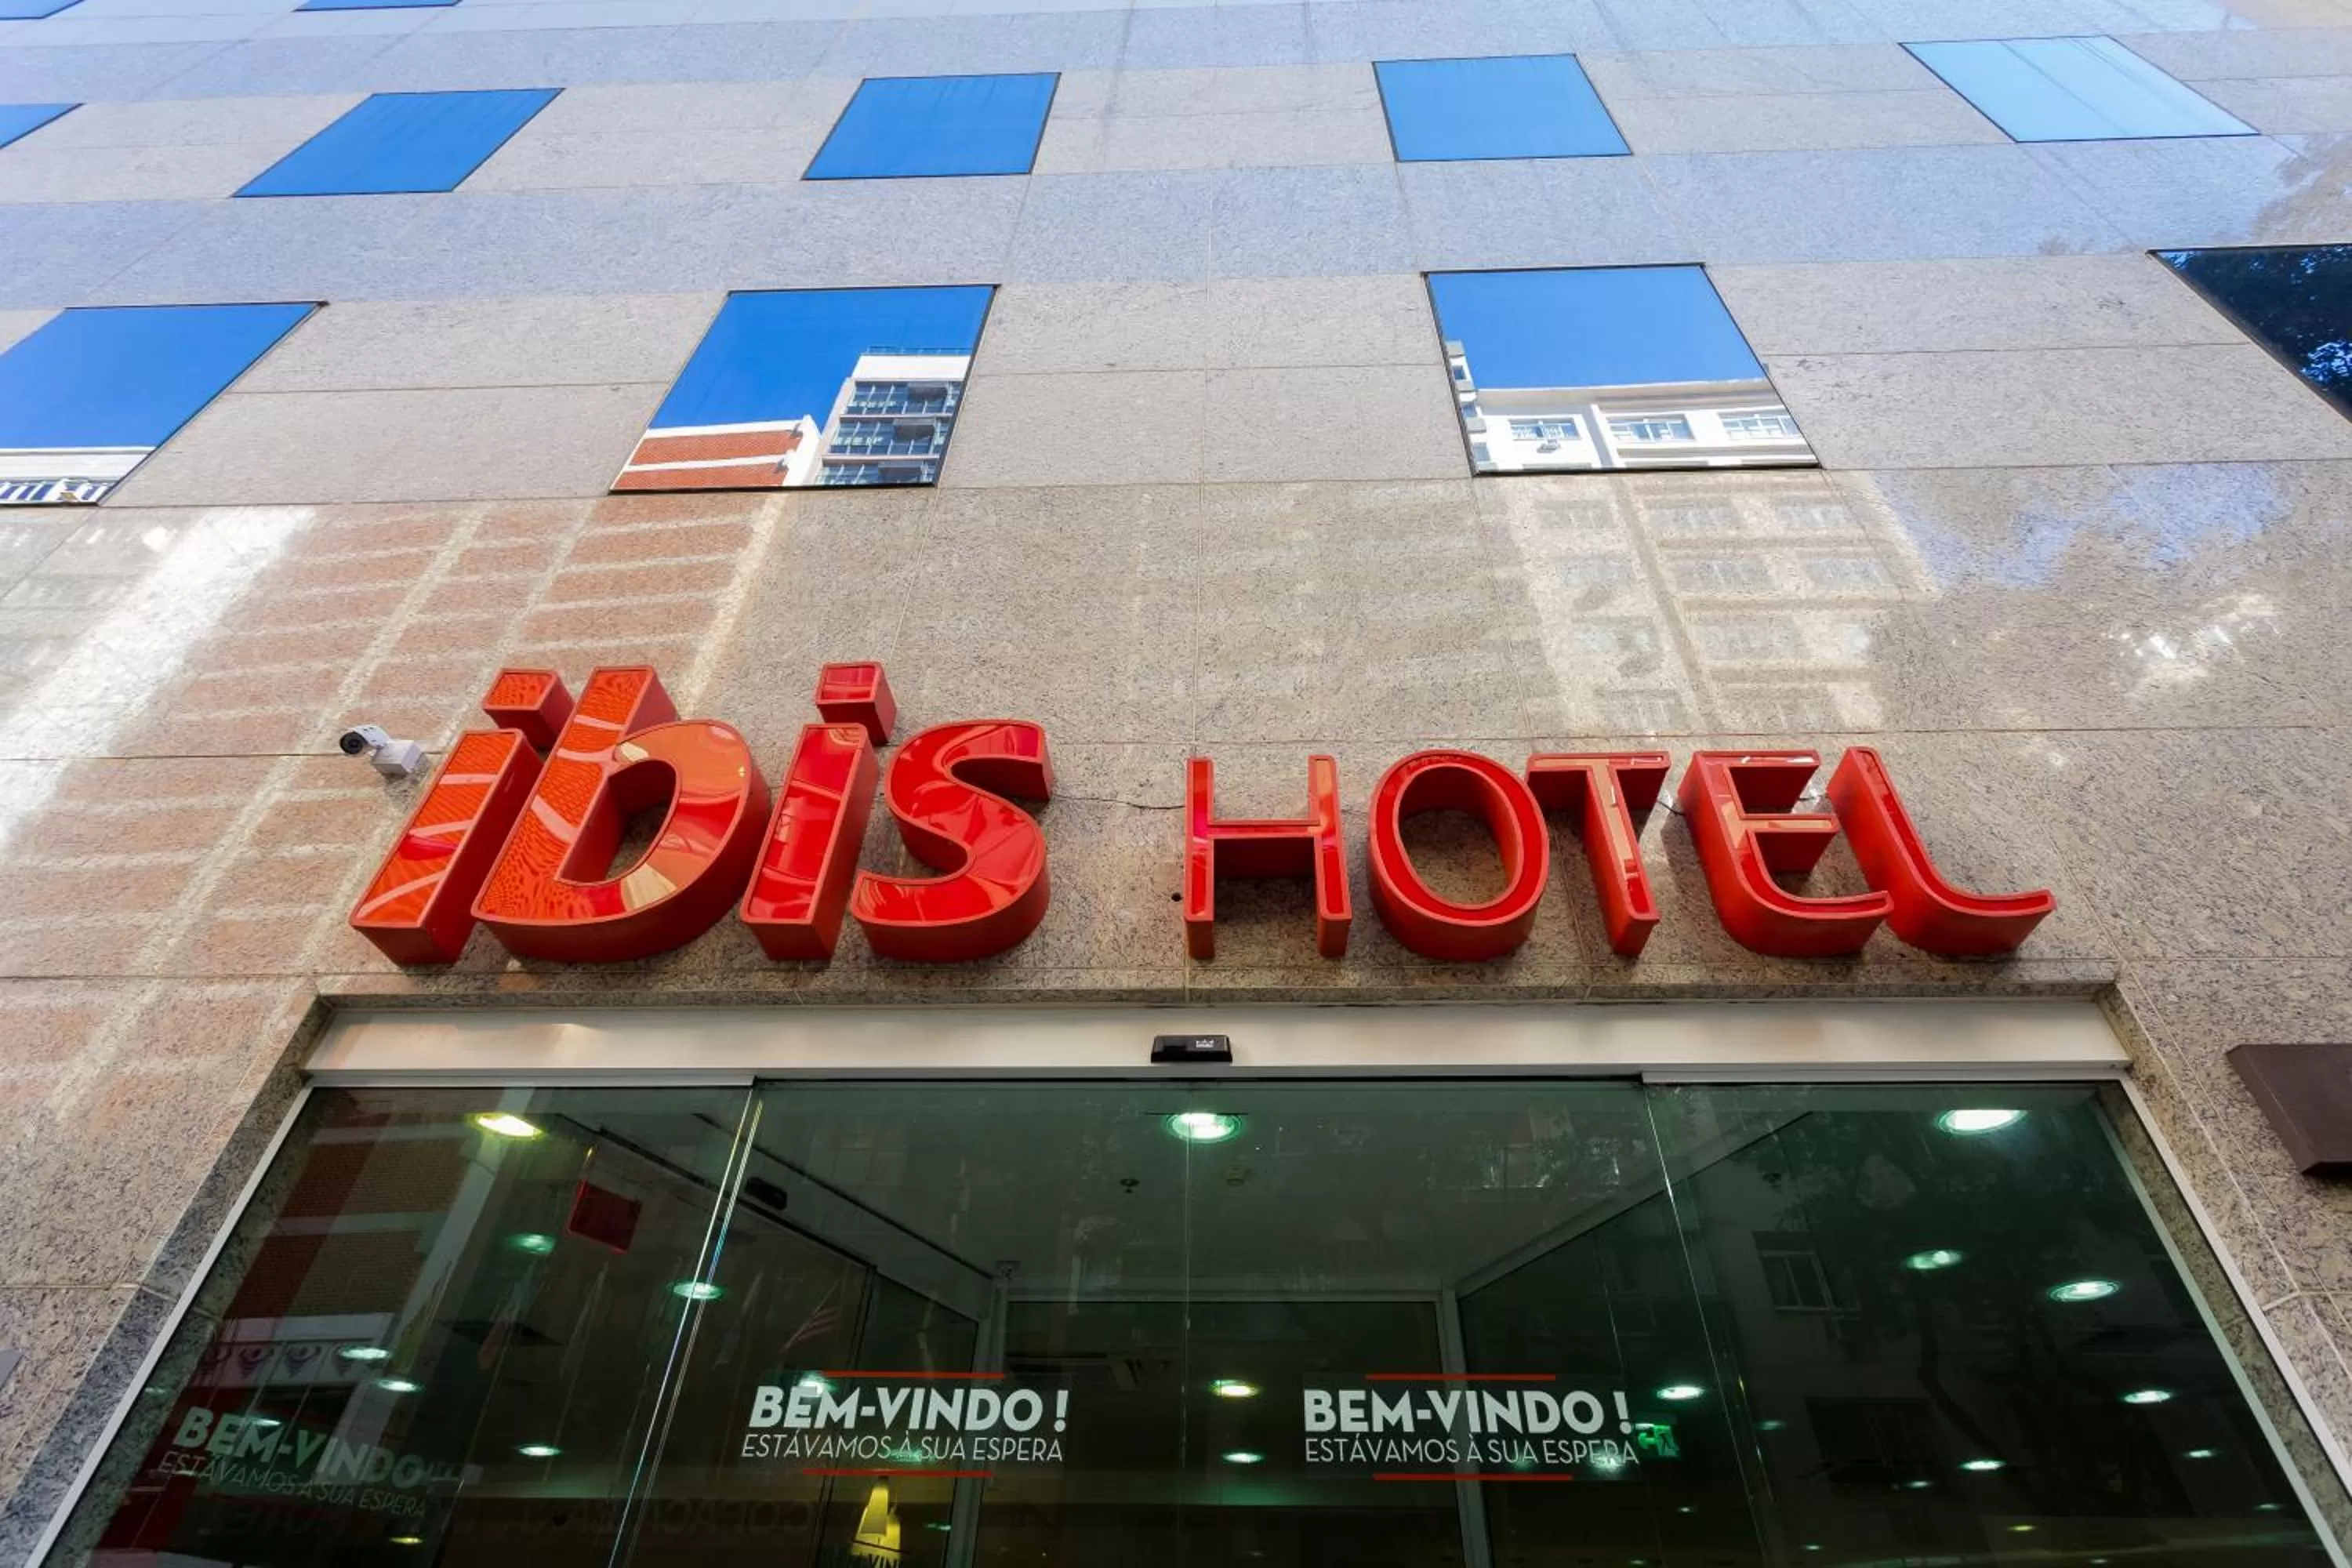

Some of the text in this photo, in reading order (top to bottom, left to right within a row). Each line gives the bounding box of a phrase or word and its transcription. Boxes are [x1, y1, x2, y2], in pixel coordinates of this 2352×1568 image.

[349, 661, 2056, 965] ibis HOTEL
[749, 1385, 1044, 1432] BEM-VINDO
[1304, 1389, 1604, 1434] BEM-VINDO
[741, 1428, 891, 1459] ESTÁVAMOS
[919, 1436, 966, 1461] SUA
[973, 1437, 1063, 1462] ESPERA
[1305, 1432, 1459, 1463] ESTÁVAMOS
[1488, 1439, 1537, 1464] SUA
[1544, 1439, 1639, 1465] ESPERA
